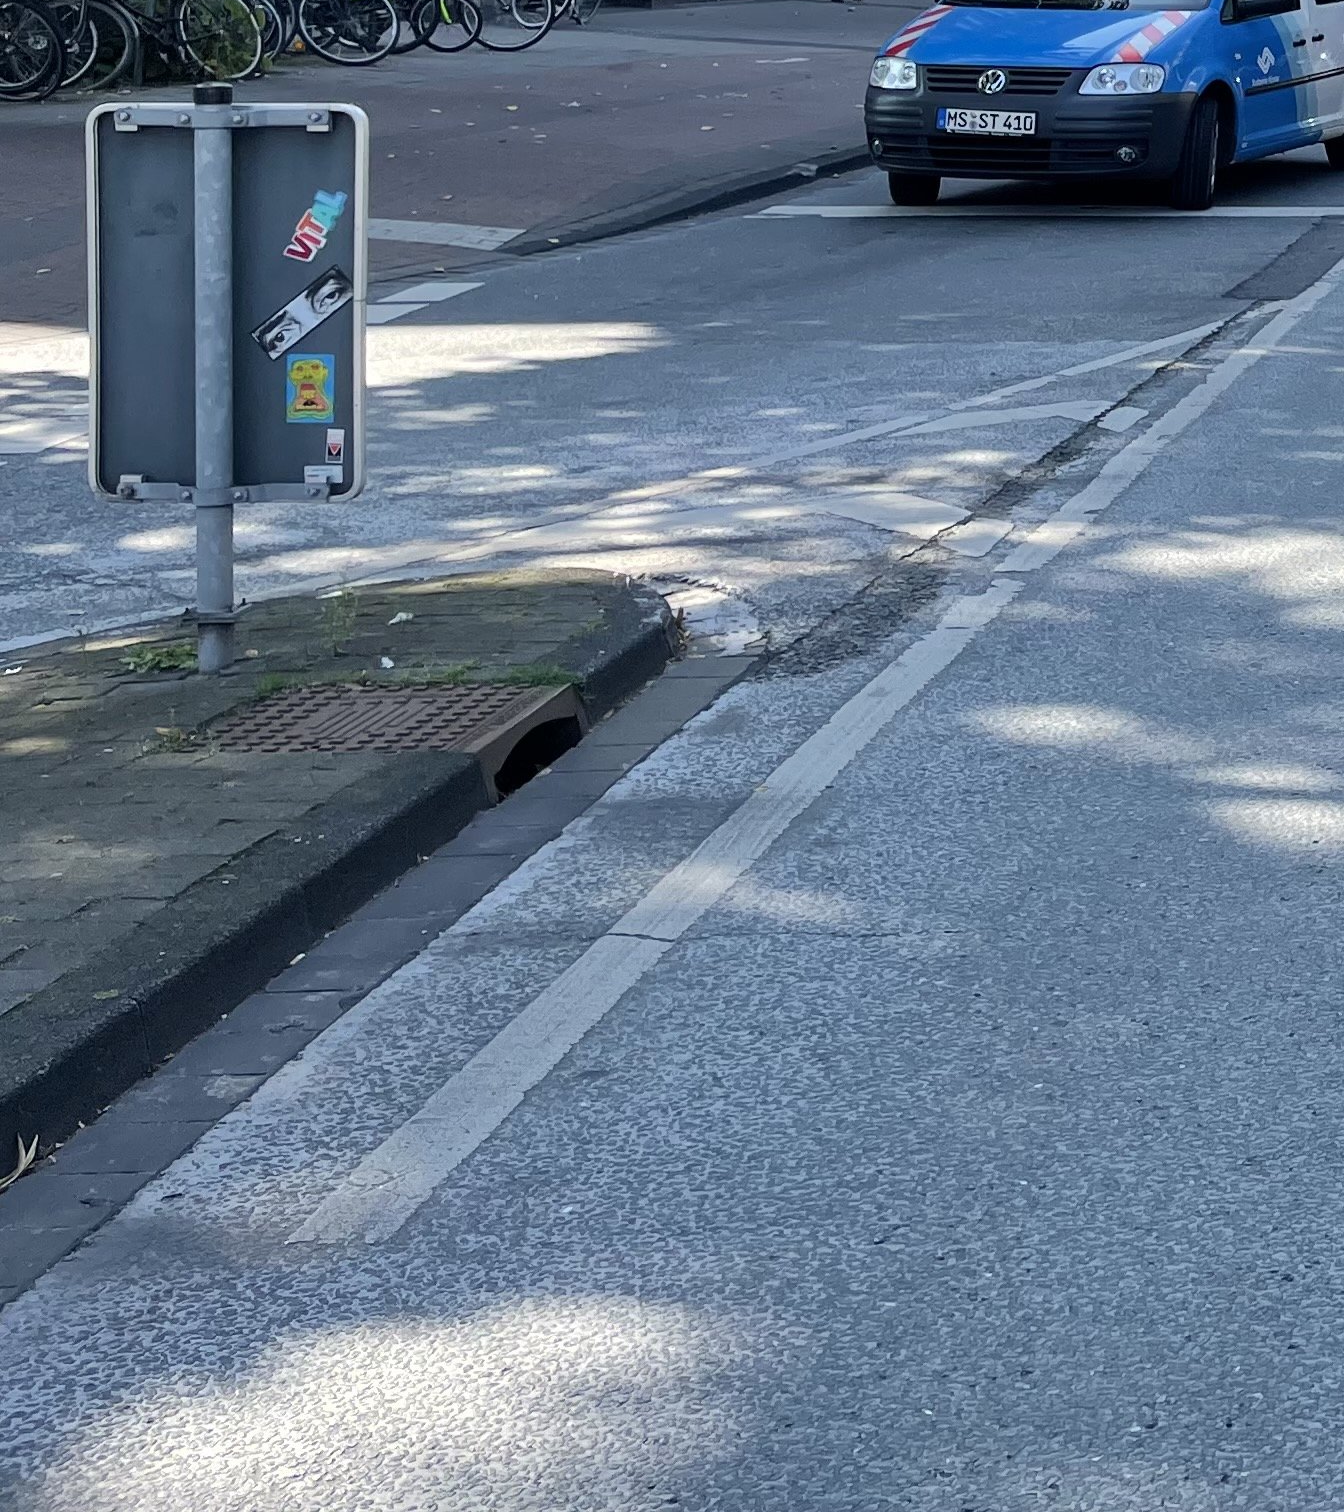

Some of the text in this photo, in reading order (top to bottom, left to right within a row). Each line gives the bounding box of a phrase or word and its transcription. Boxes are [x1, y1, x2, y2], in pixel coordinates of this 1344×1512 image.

[947, 111, 1034, 132] MS ST 410
